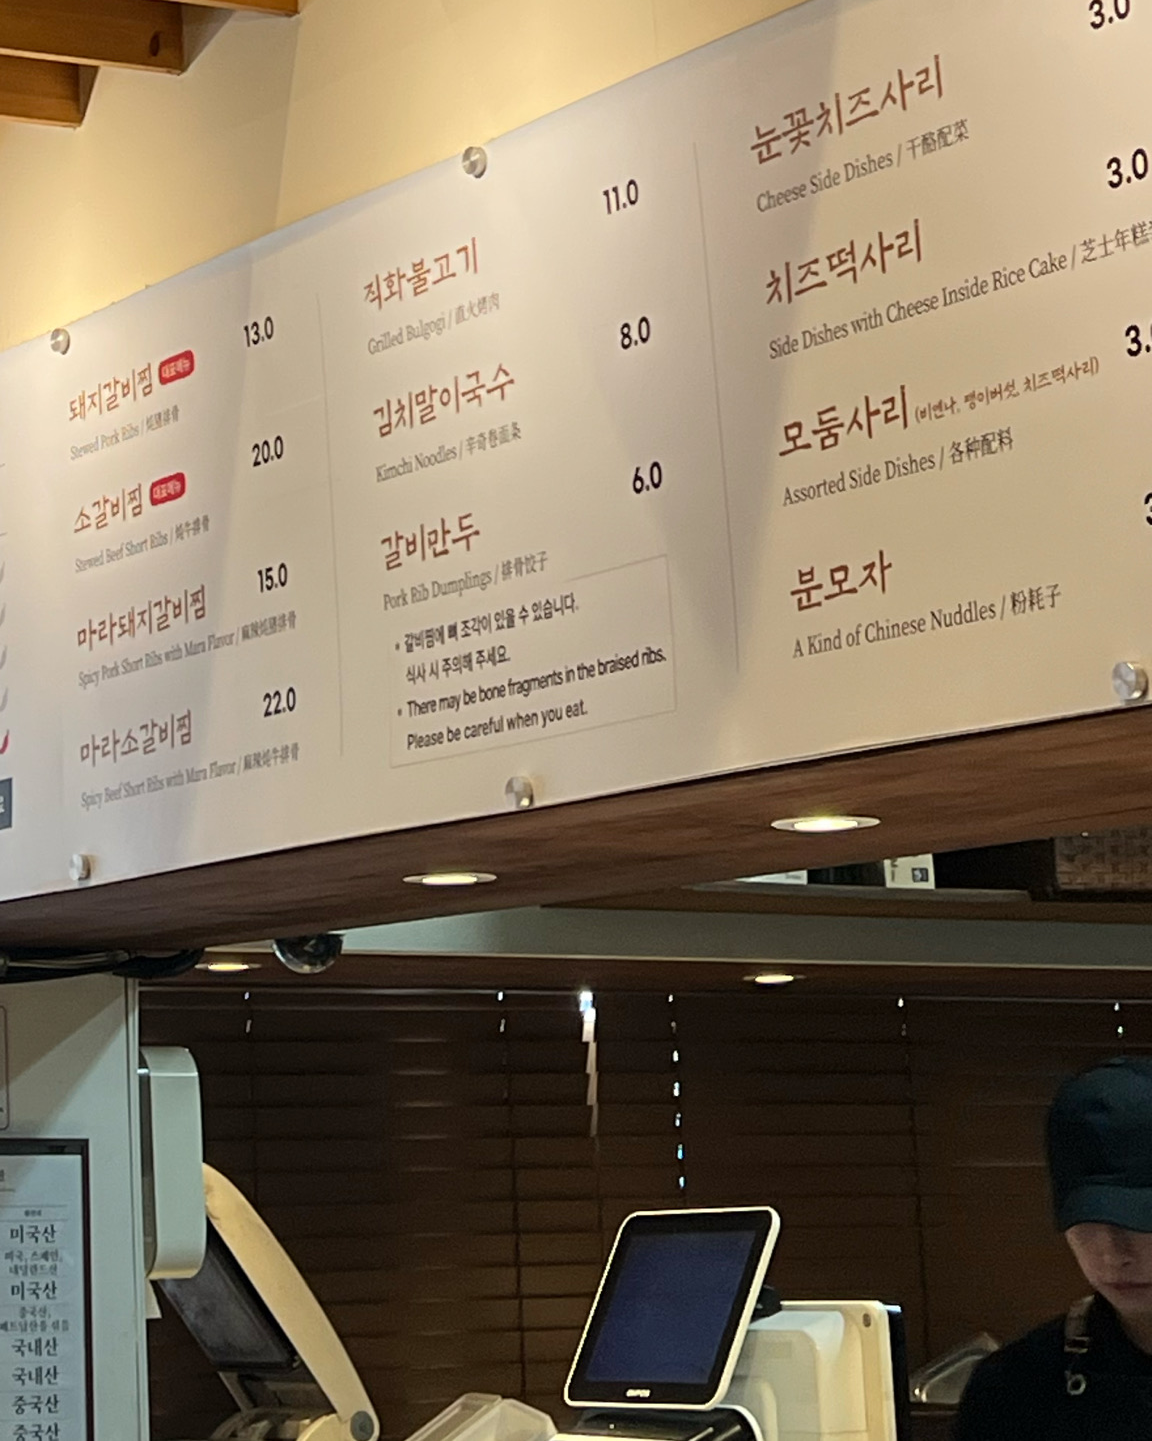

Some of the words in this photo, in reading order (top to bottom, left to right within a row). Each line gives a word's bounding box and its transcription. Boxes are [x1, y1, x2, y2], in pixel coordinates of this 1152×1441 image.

[750, 54, 943, 164] 눈꽃치즈사리
[757, 181, 807, 213] Cheese
[810, 169, 841, 195] Side
[844, 151, 893, 183] Dishes
[1106, 148, 1149, 189] 3.0
[603, 179, 639, 214] 11.0
[363, 236, 478, 310] 직화불고기
[765, 218, 923, 305] 치즈떡사리
[769, 336, 799, 360] Side
[801, 321, 848, 350] Dishes
[851, 309, 884, 333] with
[886, 296, 939, 325] Cheese
[942, 277, 989, 306] Inside
[992, 266, 1026, 292] Rice
[1029, 252, 1067, 280] Cake
[1080, 220, 1152, 264] 芝士年糕
[243, 316, 274, 347] 13.0
[368, 328, 404, 355] Grilled
[406, 312, 447, 342] Bulgogi
[620, 316, 650, 349] 8.0
[1125, 325, 1152, 357] 3.
[69, 363, 153, 421] 돼지갈비찜
[373, 363, 515, 438] 김치말이국수
[100, 431, 120, 450] Pork
[779, 385, 908, 457] 모둠사리
[252, 435, 284, 467] 20.0
[376, 458, 413, 483] Kimchi
[415, 444, 458, 471] Noodles
[632, 461, 662, 494] 6.0
[782, 473, 846, 506] Assorted
[849, 465, 881, 490] Side
[885, 451, 936, 481] Dishes
[73, 483, 143, 534] 소갈비찜
[381, 513, 480, 571] 갈비만두
[257, 563, 288, 593] 15.0
[383, 589, 409, 611] Pork
[411, 583, 430, 602] Rib
[432, 568, 492, 597] Dumplings
[790, 550, 892, 612] 분모자
[77, 584, 206, 652] 마라돼지갈비찜
[460, 613, 492, 639] 조각이
[518, 605, 529, 625] 수
[531, 592, 579, 622] 있습니다.
[793, 639, 804, 658] A
[807, 628, 842, 656] Kind
[845, 623, 862, 647] of
[865, 614, 926, 644] Chinese
[931, 600, 996, 630] Nuddles
[78, 670, 99, 689] Spicy
[101, 664, 120, 681] Pork
[121, 656, 144, 676] Short
[406, 662, 426, 685] 식사
[429, 660, 439, 680] 시
[408, 698, 437, 718] There
[439, 693, 461, 714] may
[463, 689, 477, 706] be
[479, 682, 506, 702] bone
[507, 670, 563, 697] fragments
[565, 666, 576, 683] in
[577, 661, 596, 680] the
[598, 652, 639, 675] braised
[263, 687, 296, 717] 22.0
[80, 709, 192, 767] 마라소갈비찜
[407, 726, 444, 750] Please
[447, 723, 461, 742] be
[464, 714, 504, 739] careful
[506, 708, 539, 731] when
[541, 706, 563, 728] you
[565, 699, 588, 719] eat.
[81, 791, 102, 811] Spicy
[10, 1224, 57, 1244] 미국산
[11, 1280, 58, 1301] 미국산
[11, 1337, 58, 1358] 국내산
[12, 1366, 59, 1387] 국내산
[12, 1394, 59, 1415] 중국산
